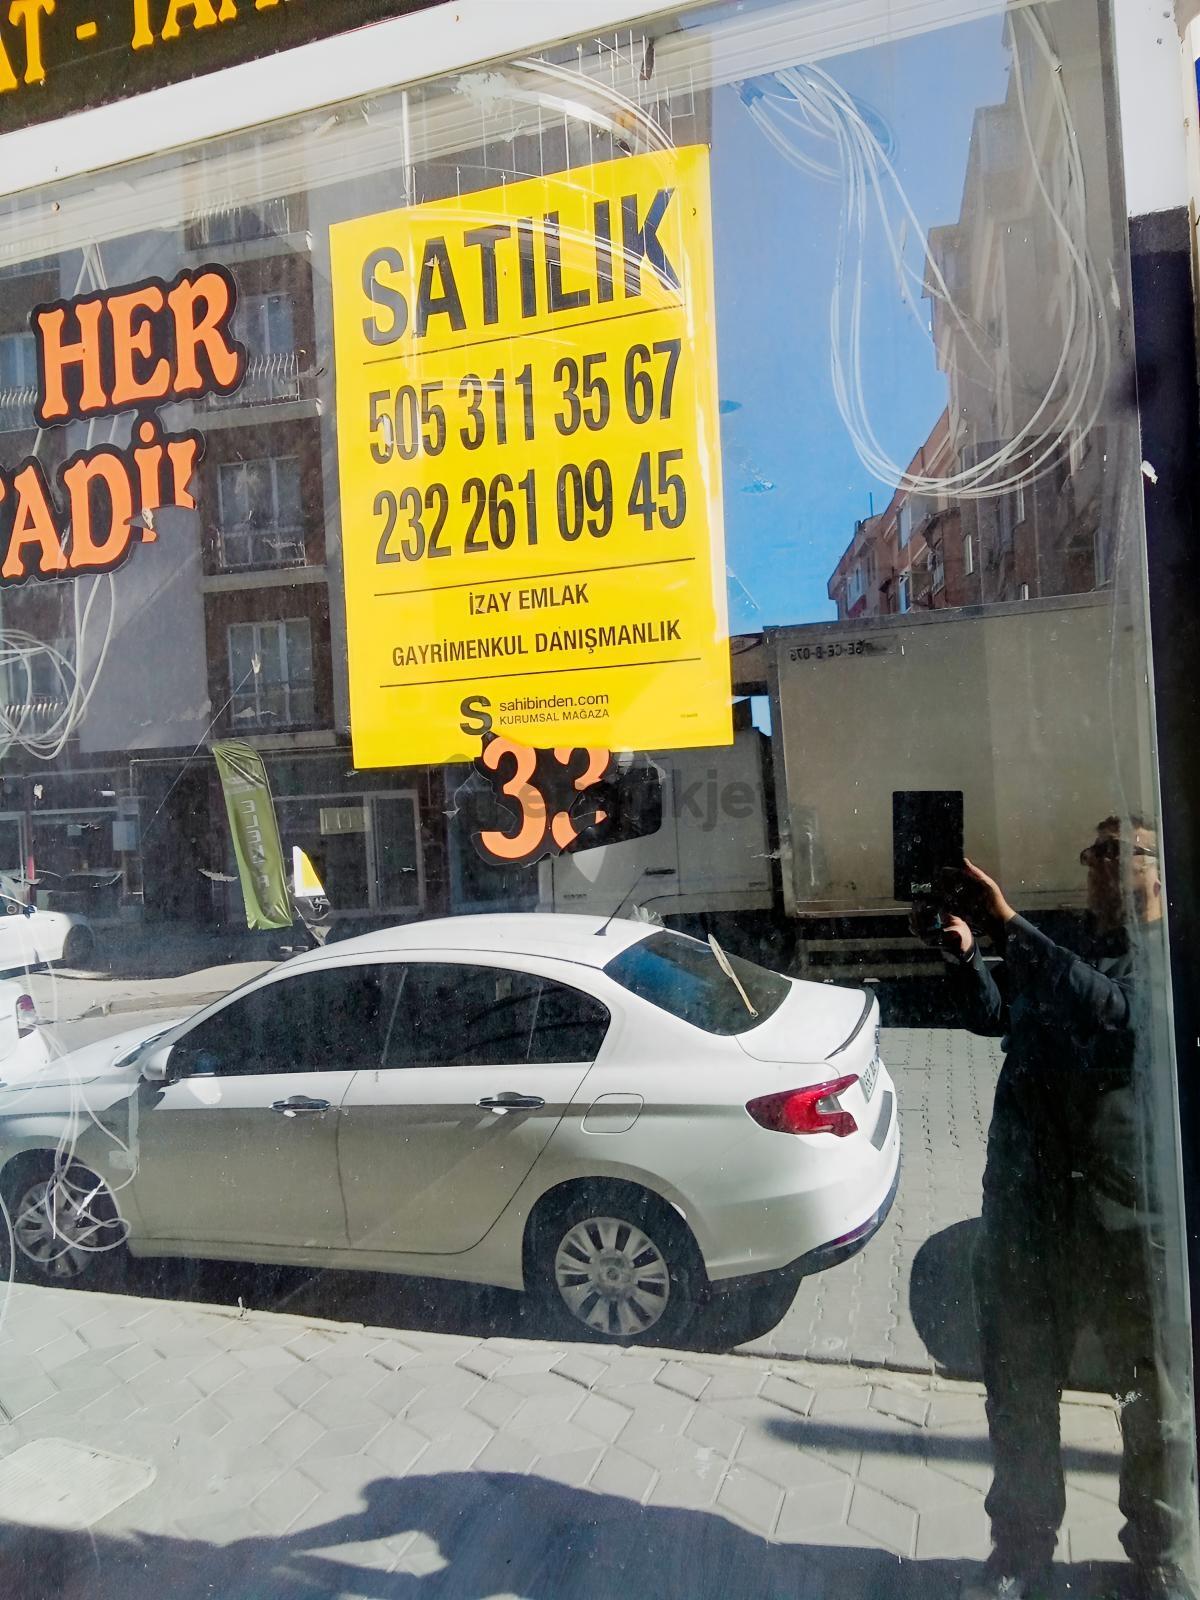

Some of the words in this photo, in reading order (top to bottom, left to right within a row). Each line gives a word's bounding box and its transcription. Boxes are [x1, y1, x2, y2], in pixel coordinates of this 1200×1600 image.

[361, 187, 682, 346] SATILIK
[37, 271, 238, 419] HER
[368, 381, 447, 464] 505
[458, 363, 535, 451] 311
[553, 352, 611, 436] 35
[624, 337, 682, 425] 67
[373, 482, 452, 565] 232
[461, 468, 539, 554] 261
[556, 458, 614, 542] 09
[627, 448, 687, 532] 45
[469, 591, 511, 615] İZAY
[518, 583, 590, 610] EMLAK
[392, 636, 528, 667] GAYRİMENKUL
[535, 619, 682, 654] DANIŞMANLIK
[499, 693, 610, 713] sahibinden.com
[499, 711, 560, 726] KURUMSAL
[562, 708, 610, 722] MAĞAZA
